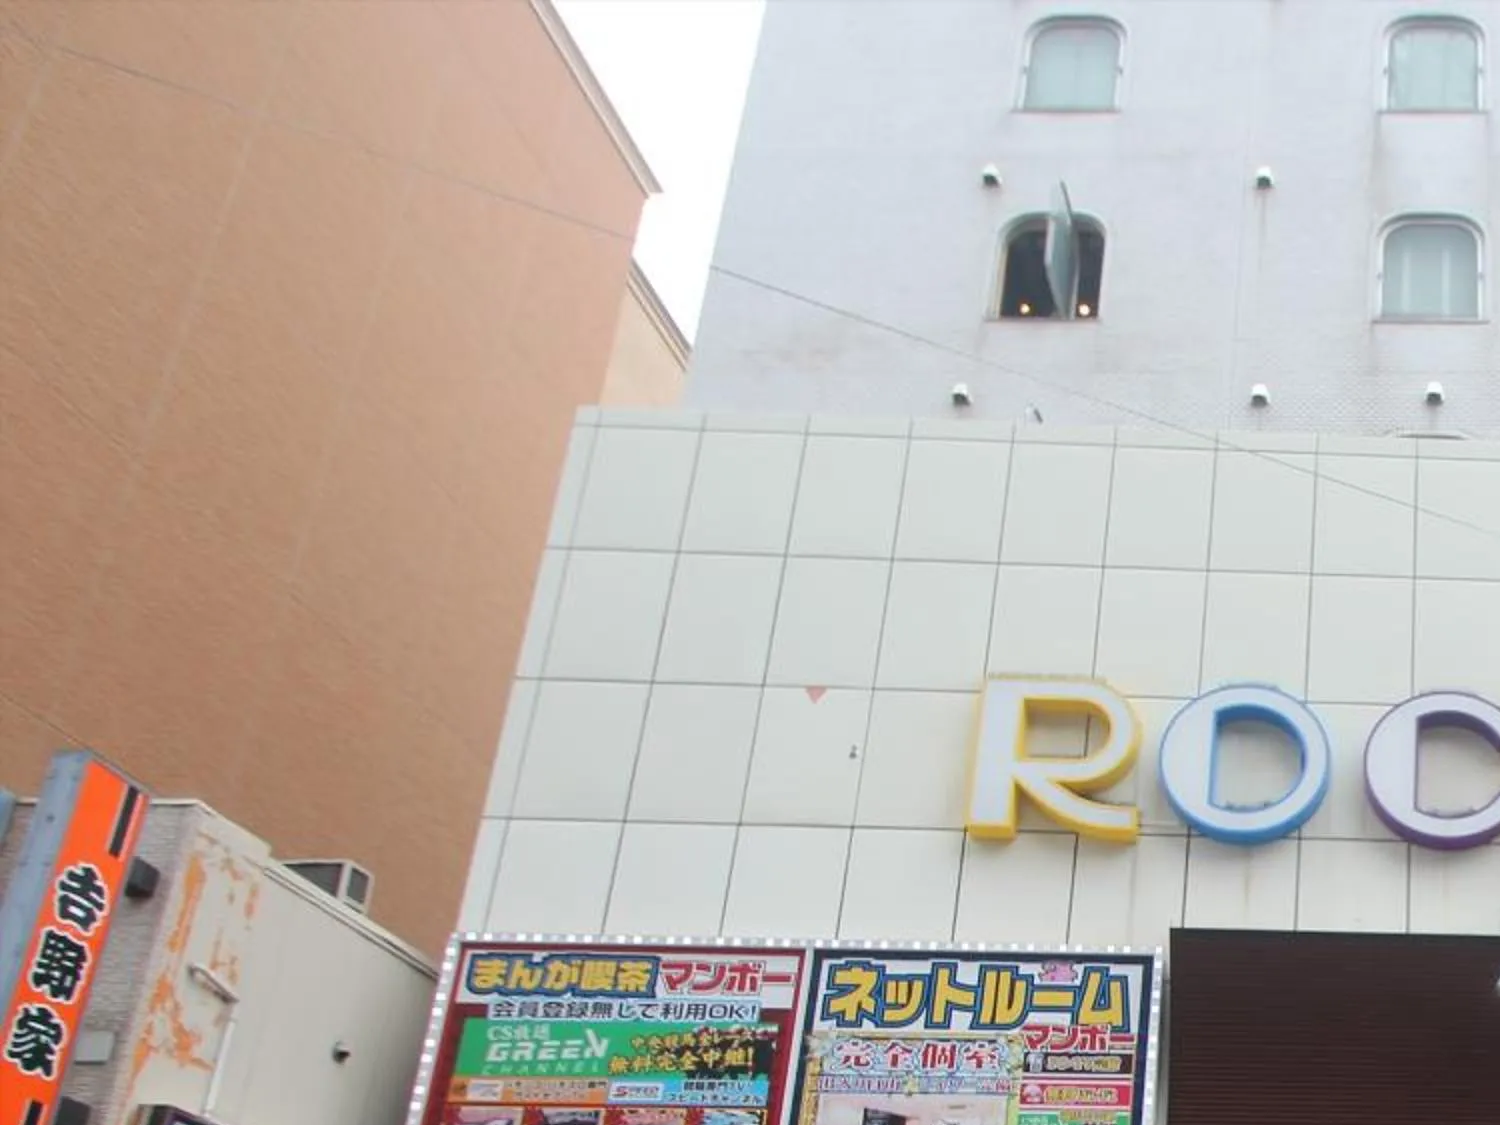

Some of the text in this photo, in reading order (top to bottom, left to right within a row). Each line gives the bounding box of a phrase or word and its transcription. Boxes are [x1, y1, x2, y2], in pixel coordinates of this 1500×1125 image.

[5, 863, 107, 1079] 吉野家
[472, 955, 795, 995] まんが喫茶 マンボー
[826, 962, 1127, 1028] ネットルーム
[486, 1027, 609, 1062] GREEN
[1021, 1023, 1136, 1051] マンボー
